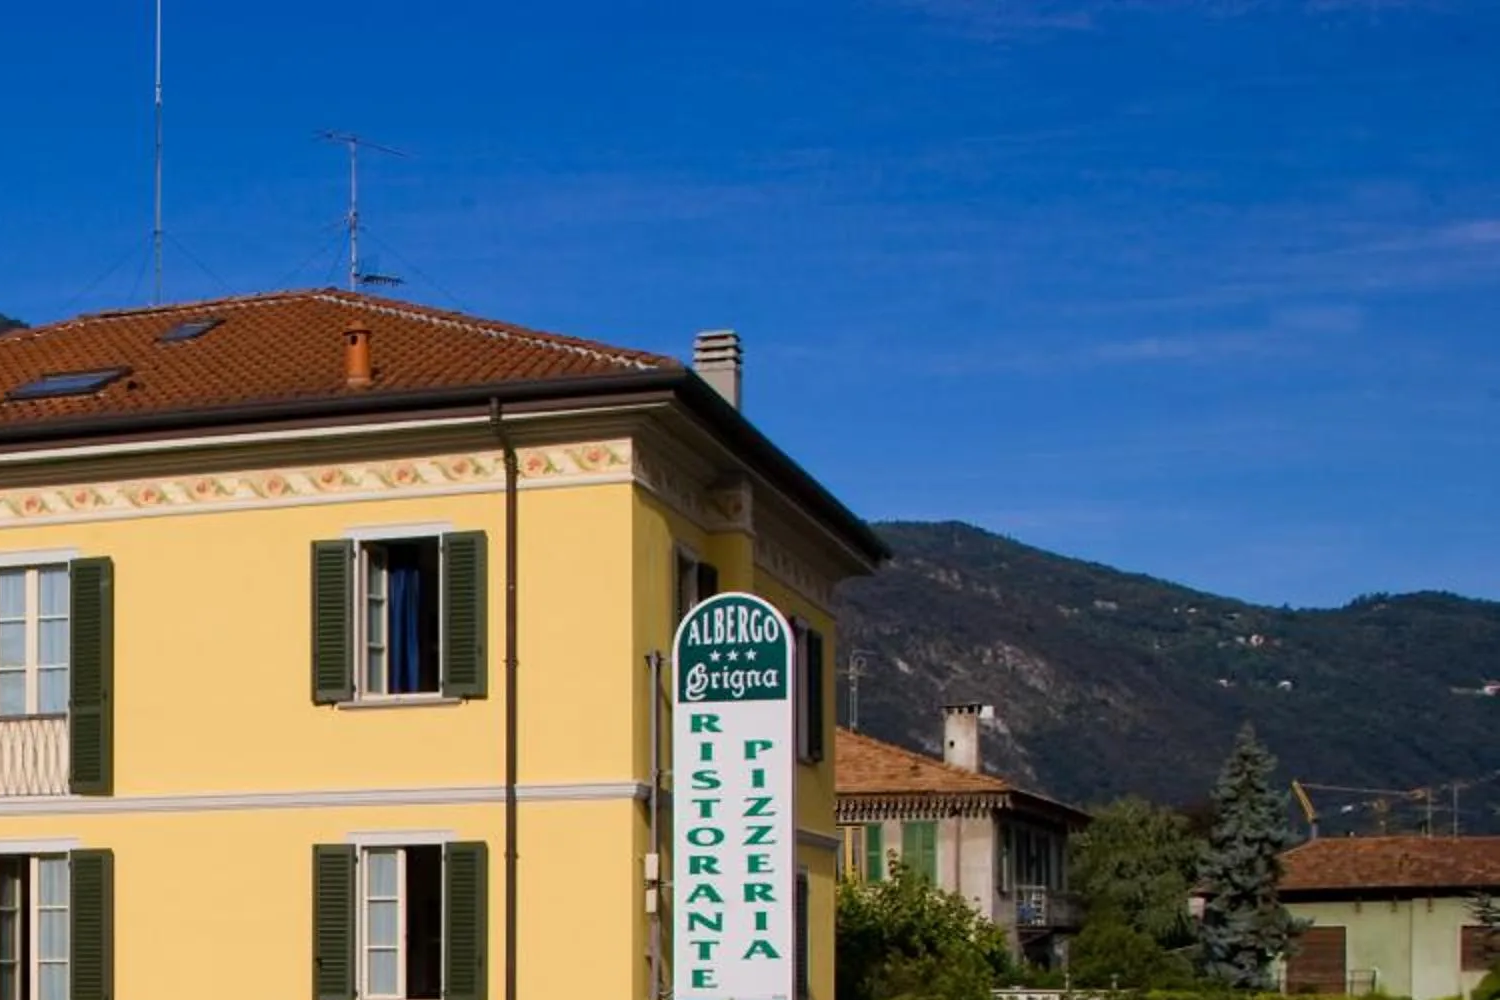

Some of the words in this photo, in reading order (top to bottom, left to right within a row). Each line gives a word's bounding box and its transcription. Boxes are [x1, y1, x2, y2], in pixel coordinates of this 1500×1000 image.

[685, 662, 779, 699] Grigna
[687, 605, 779, 646] ALBERGO
[686, 713, 725, 989] RISTORANTE
[742, 739, 782, 960] PIZZERIA
